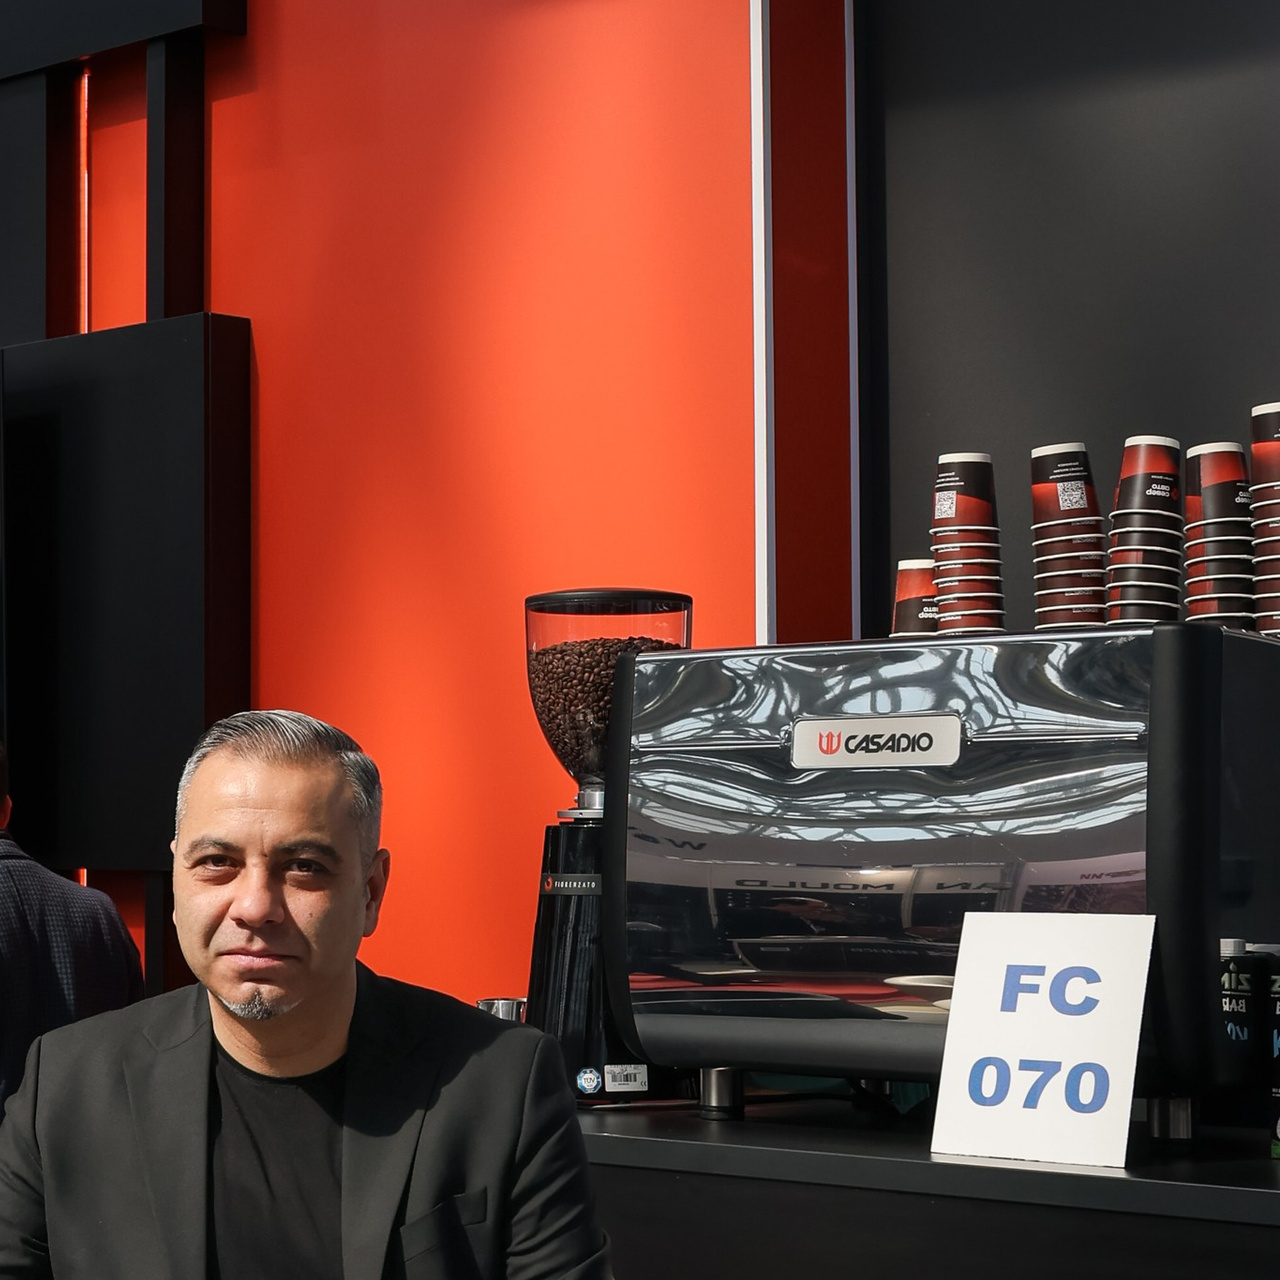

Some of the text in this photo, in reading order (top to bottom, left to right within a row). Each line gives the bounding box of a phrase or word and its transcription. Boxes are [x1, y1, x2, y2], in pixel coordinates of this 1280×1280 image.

[844, 731, 934, 754] CASADIO
[554, 880, 596, 888] FIORENZATO
[1000, 964, 1102, 1017] FC
[968, 1056, 1110, 1114] 070
